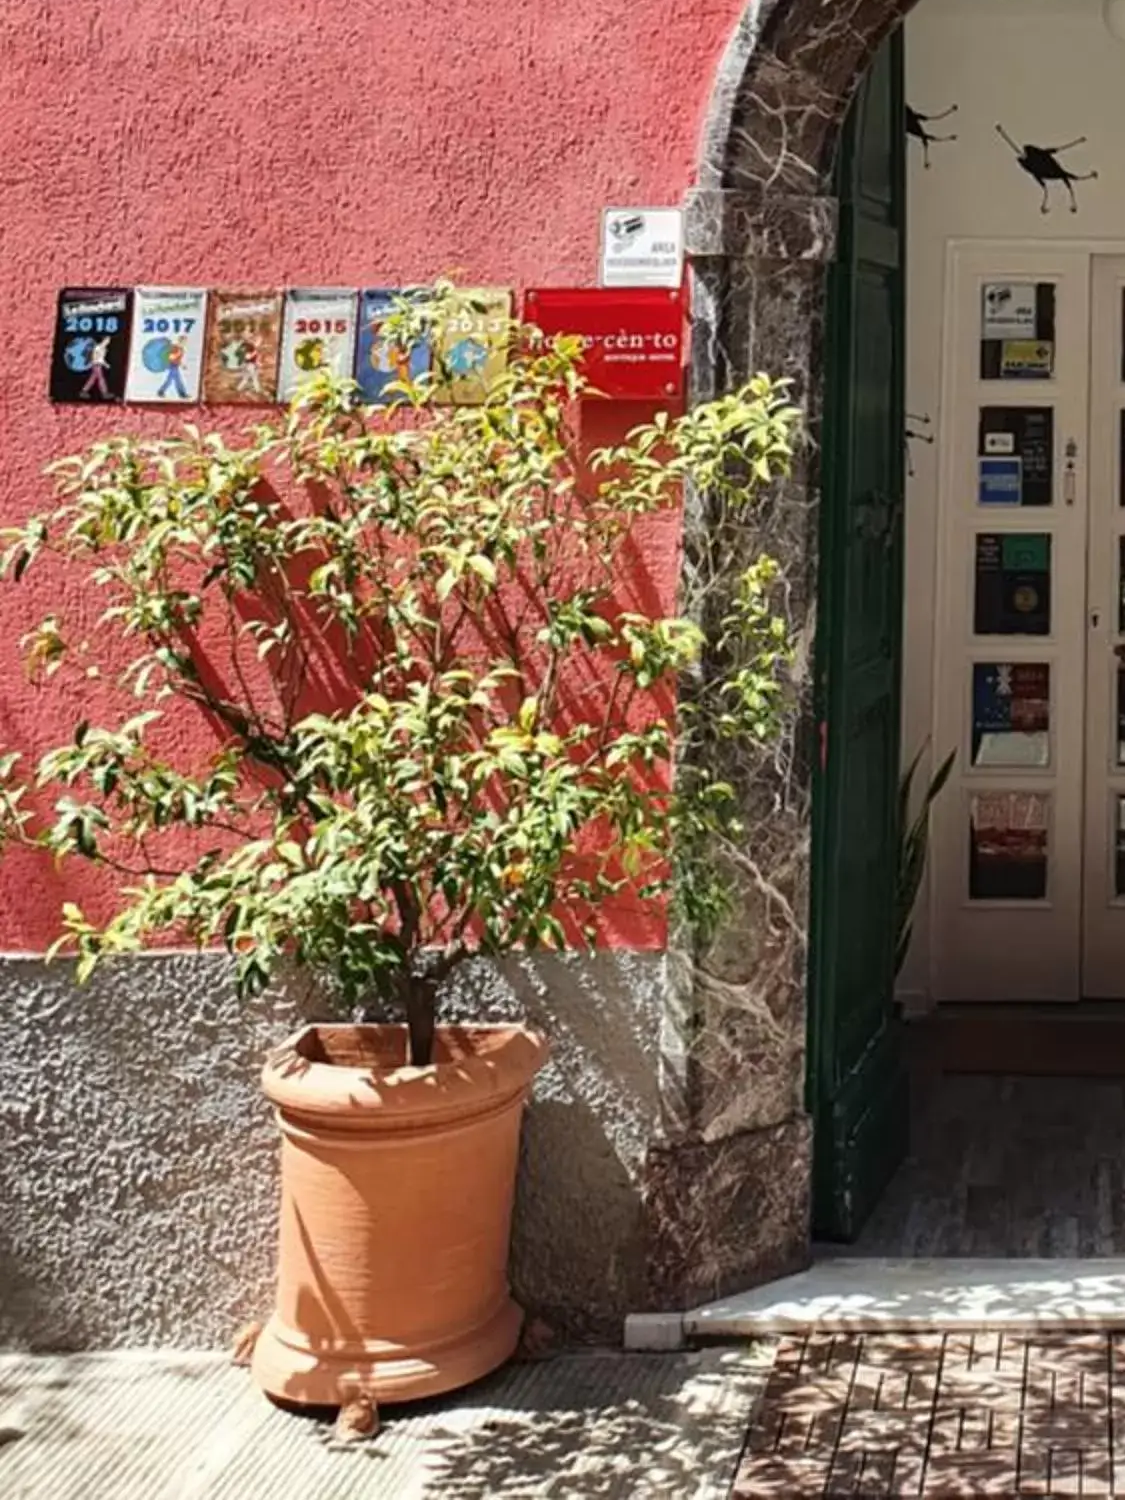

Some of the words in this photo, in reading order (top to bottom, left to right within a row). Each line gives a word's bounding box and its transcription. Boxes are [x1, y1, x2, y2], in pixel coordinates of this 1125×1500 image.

[64, 316, 118, 333] 2018
[142, 318, 196, 333] 2017
[295, 319, 347, 334] 2015
[449, 319, 500, 333] 2013
